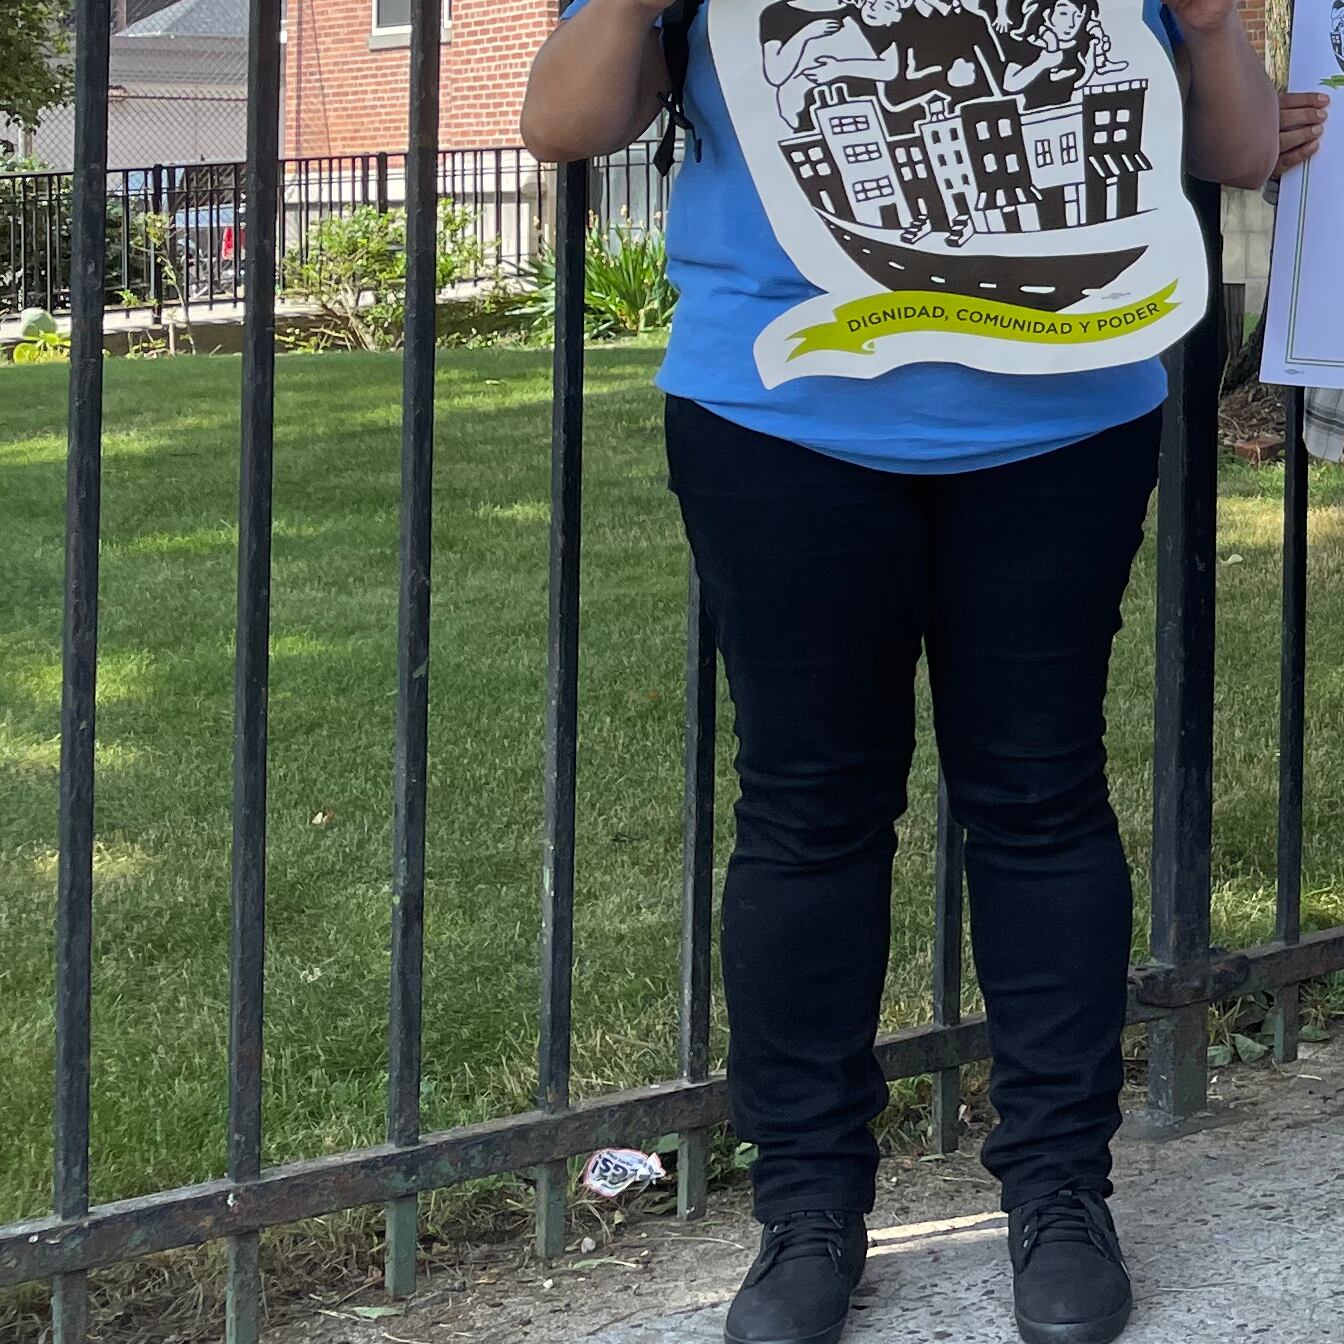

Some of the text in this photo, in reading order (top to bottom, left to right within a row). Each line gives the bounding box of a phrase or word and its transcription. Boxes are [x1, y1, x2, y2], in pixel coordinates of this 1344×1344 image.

[847, 302, 1161, 335] DIGNIDAD, COMUNIDAD Y PODER
